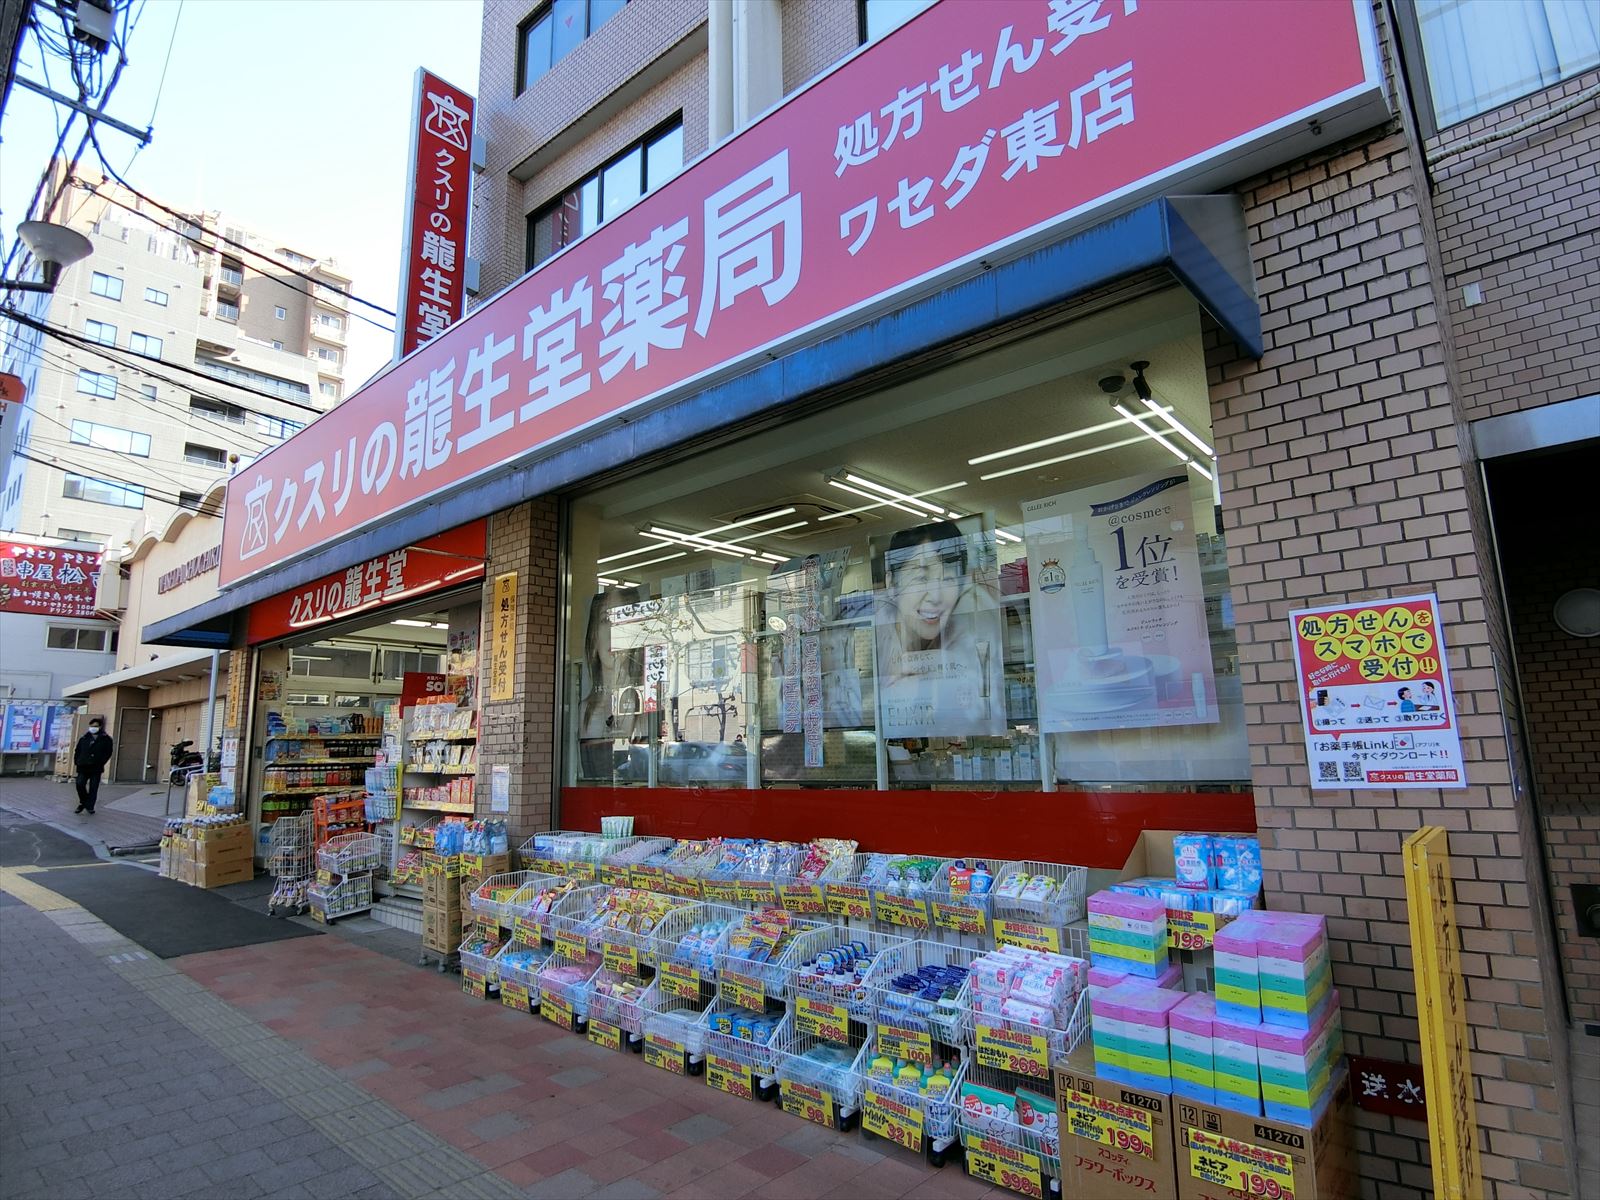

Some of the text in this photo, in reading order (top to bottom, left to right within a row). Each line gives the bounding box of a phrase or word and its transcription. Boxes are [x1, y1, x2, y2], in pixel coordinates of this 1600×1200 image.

[834, 0, 1137, 178] 処方せん受
[839, 60, 1135, 257] ワセダ東店
[416, 148, 457, 350] クスリの龍生堂
[274, 147, 804, 546] クスリの龍生堂薬局
[11, 546, 56, 561] やきとり
[1110, 526, 1175, 571] 1位
[289, 549, 408, 626] クスリの龍生堂
[1301, 611, 1430, 637] 処方せんを
[497, 597, 511, 693] 処方せん受付
[1318, 632, 1427, 657] スマホで
[426, 681, 445, 692] SO
[977, 1045, 1008, 1059] はだおもい
[1061, 1076, 1072, 1090] 12
[1123, 1091, 1160, 1111] 41270
[1076, 1111, 1097, 1123] ネピア
[1182, 1105, 1195, 1121] 12
[1257, 1127, 1301, 1148] 41270
[1098, 1147, 1129, 1165] スコッティ
[1198, 1156, 1229, 1171] ネピア
[1074, 1154, 1158, 1194] フラワーボックス
